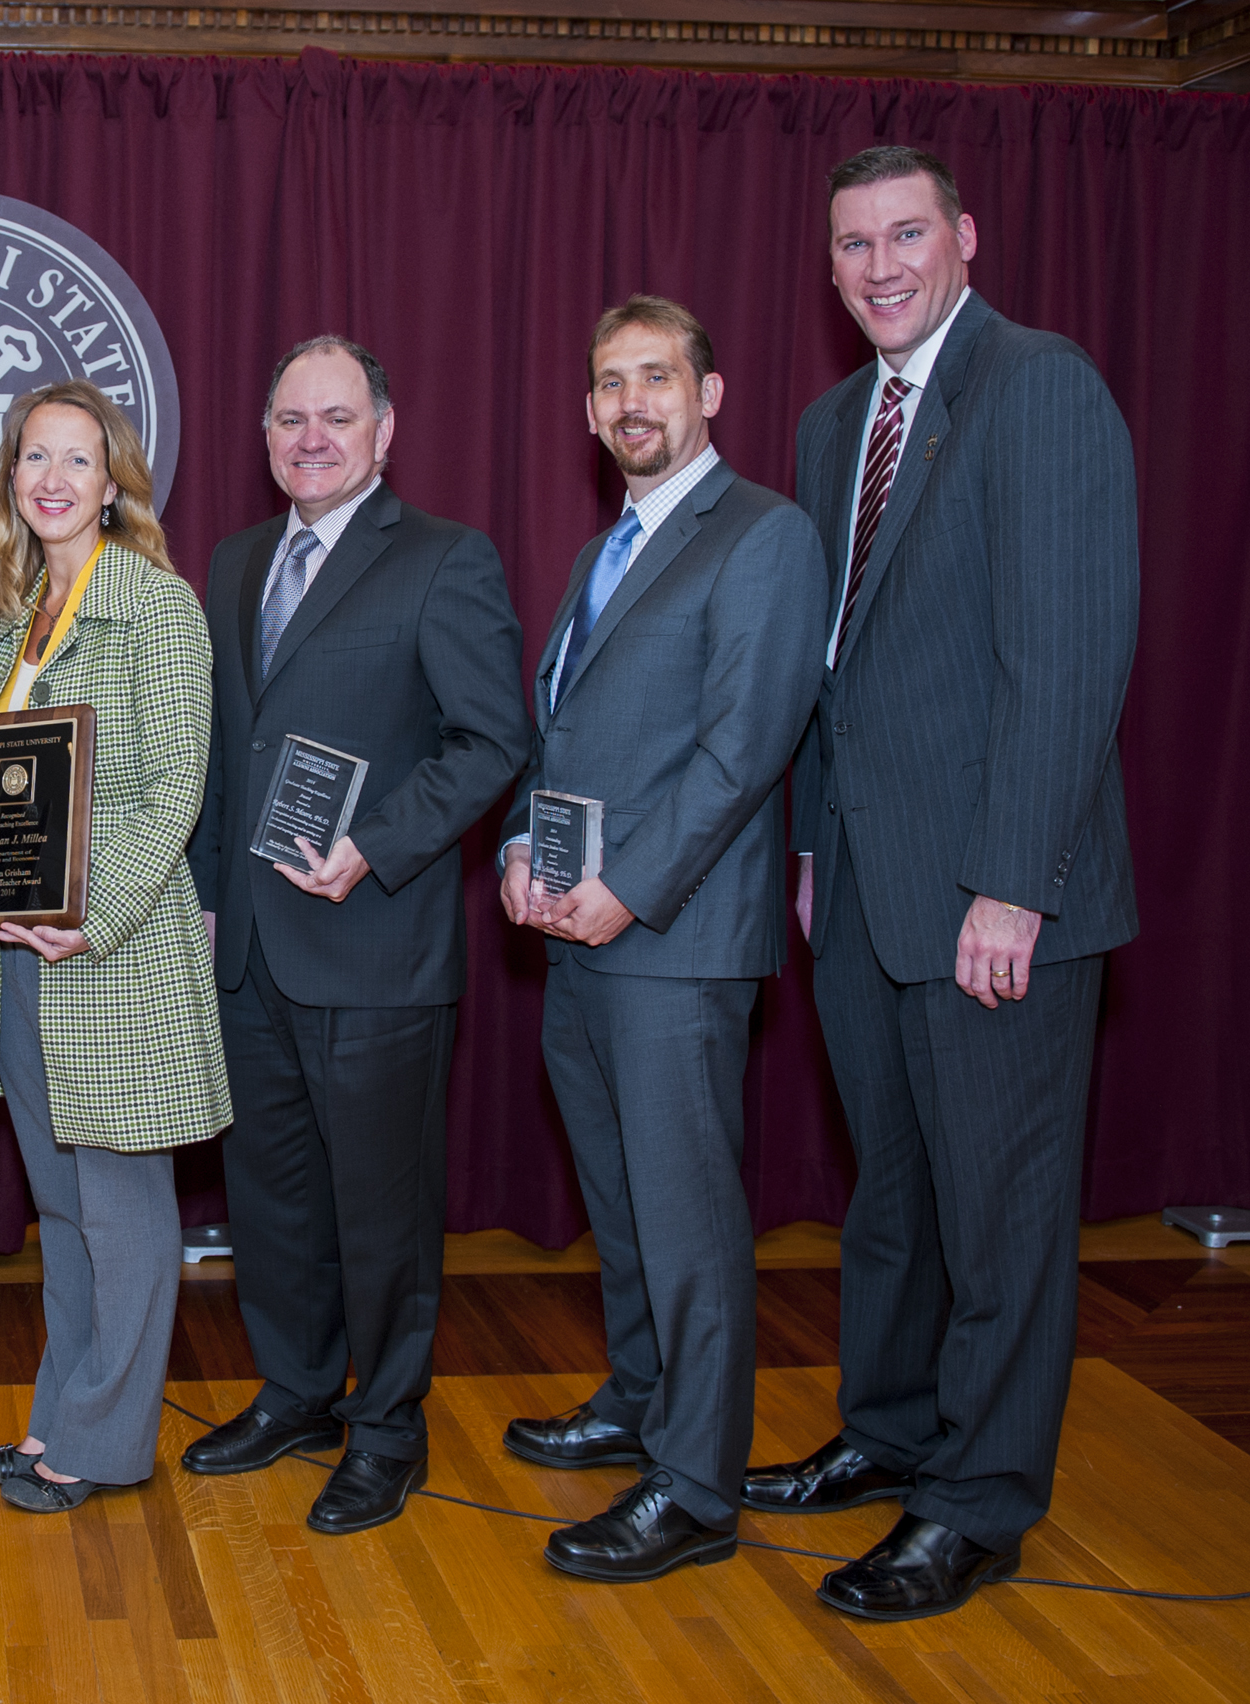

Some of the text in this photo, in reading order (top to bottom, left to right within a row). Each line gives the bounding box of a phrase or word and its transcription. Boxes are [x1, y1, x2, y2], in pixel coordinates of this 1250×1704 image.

[26, 268, 136, 406] STATE
[6, 740, 25, 749] STATE
[26, 736, 62, 747] UNIVERSITY
[11, 835, 19, 845] J.
[21, 833, 48, 844] Millea
[5, 868, 32, 877] Grisham
[0, 879, 21, 887] Teacher
[22, 877, 42, 886] Award
[0, 889, 16, 897] 2014
